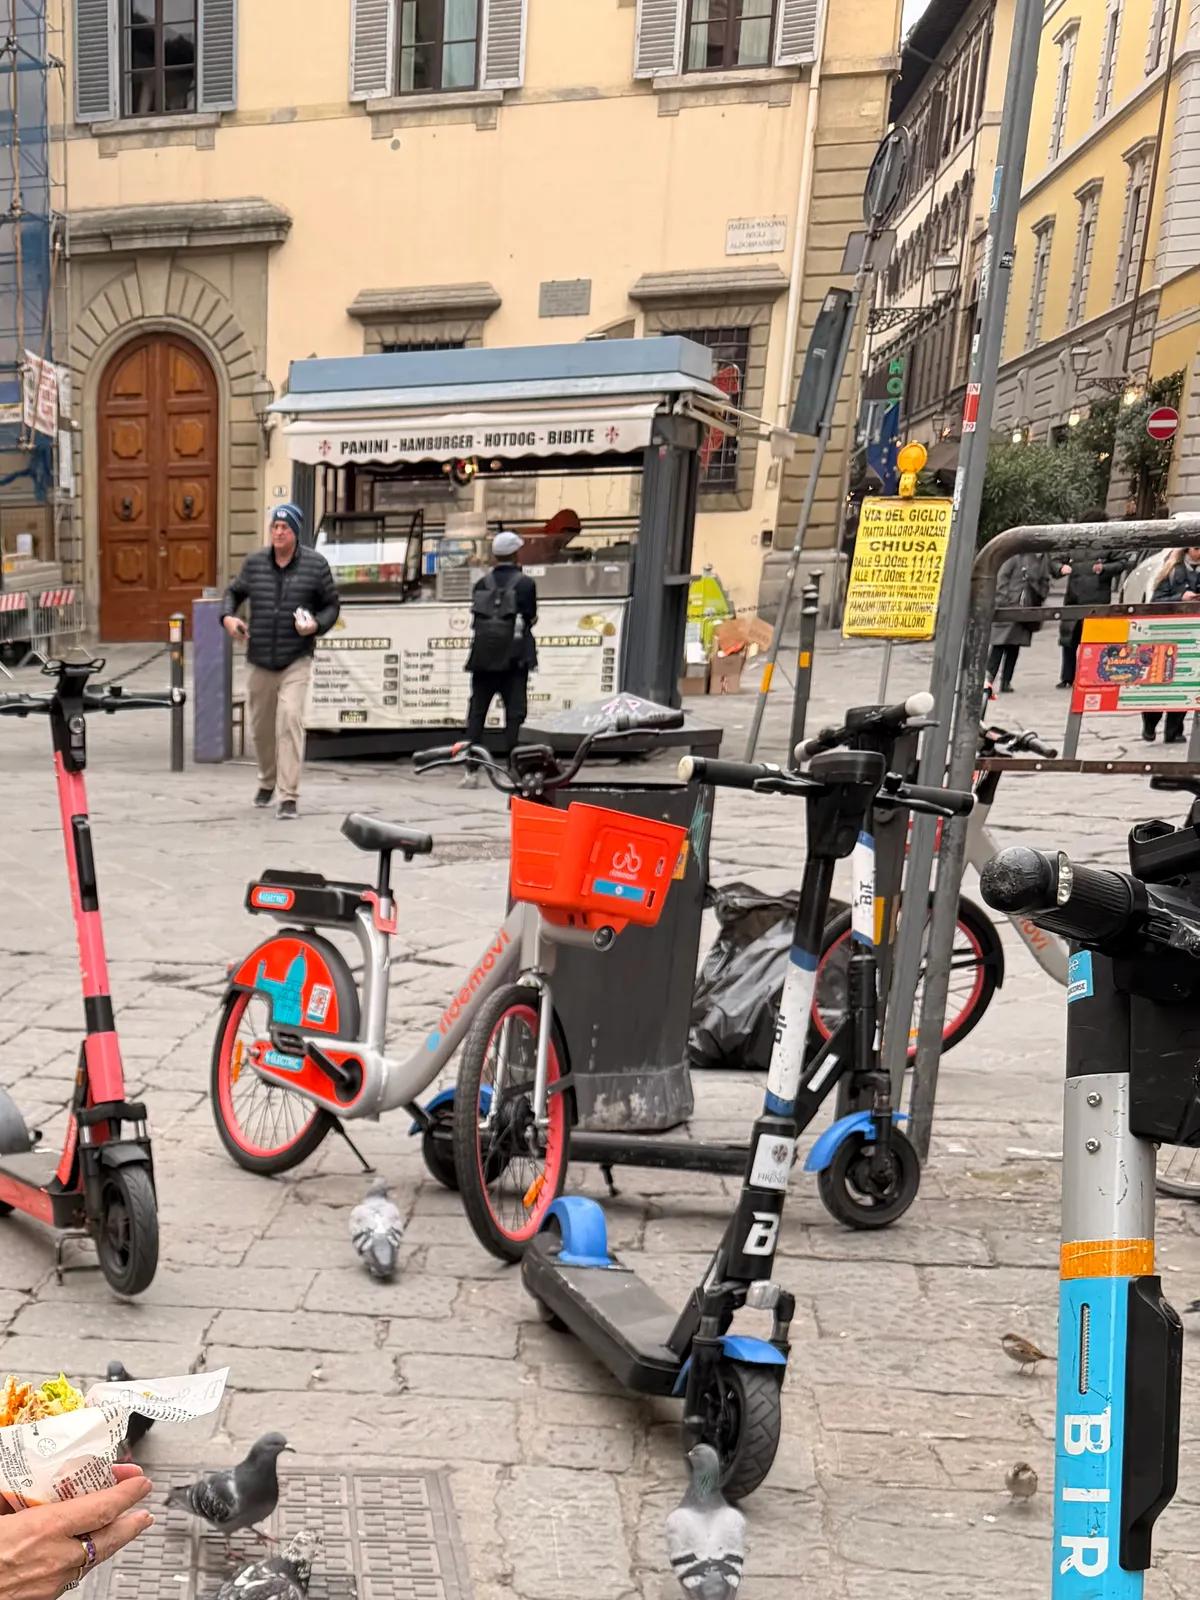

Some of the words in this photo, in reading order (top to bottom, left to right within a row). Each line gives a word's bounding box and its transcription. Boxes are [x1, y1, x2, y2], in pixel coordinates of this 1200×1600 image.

[339, 441, 389, 456] PANINI
[399, 434, 474, 453] HAMBURGER
[484, 431, 536, 448] HOTDOG
[547, 428, 596, 445] BIBITE
[864, 509, 881, 522] VIA
[885, 509, 905, 522] DEL
[908, 508, 947, 522] GIGLIO
[869, 540, 938, 553] CHIUSA
[911, 555, 942, 569] 11/12
[909, 570, 941, 583] 12/12
[438, 927, 510, 1036] ridemovi
[742, 1211, 780, 1257] B
